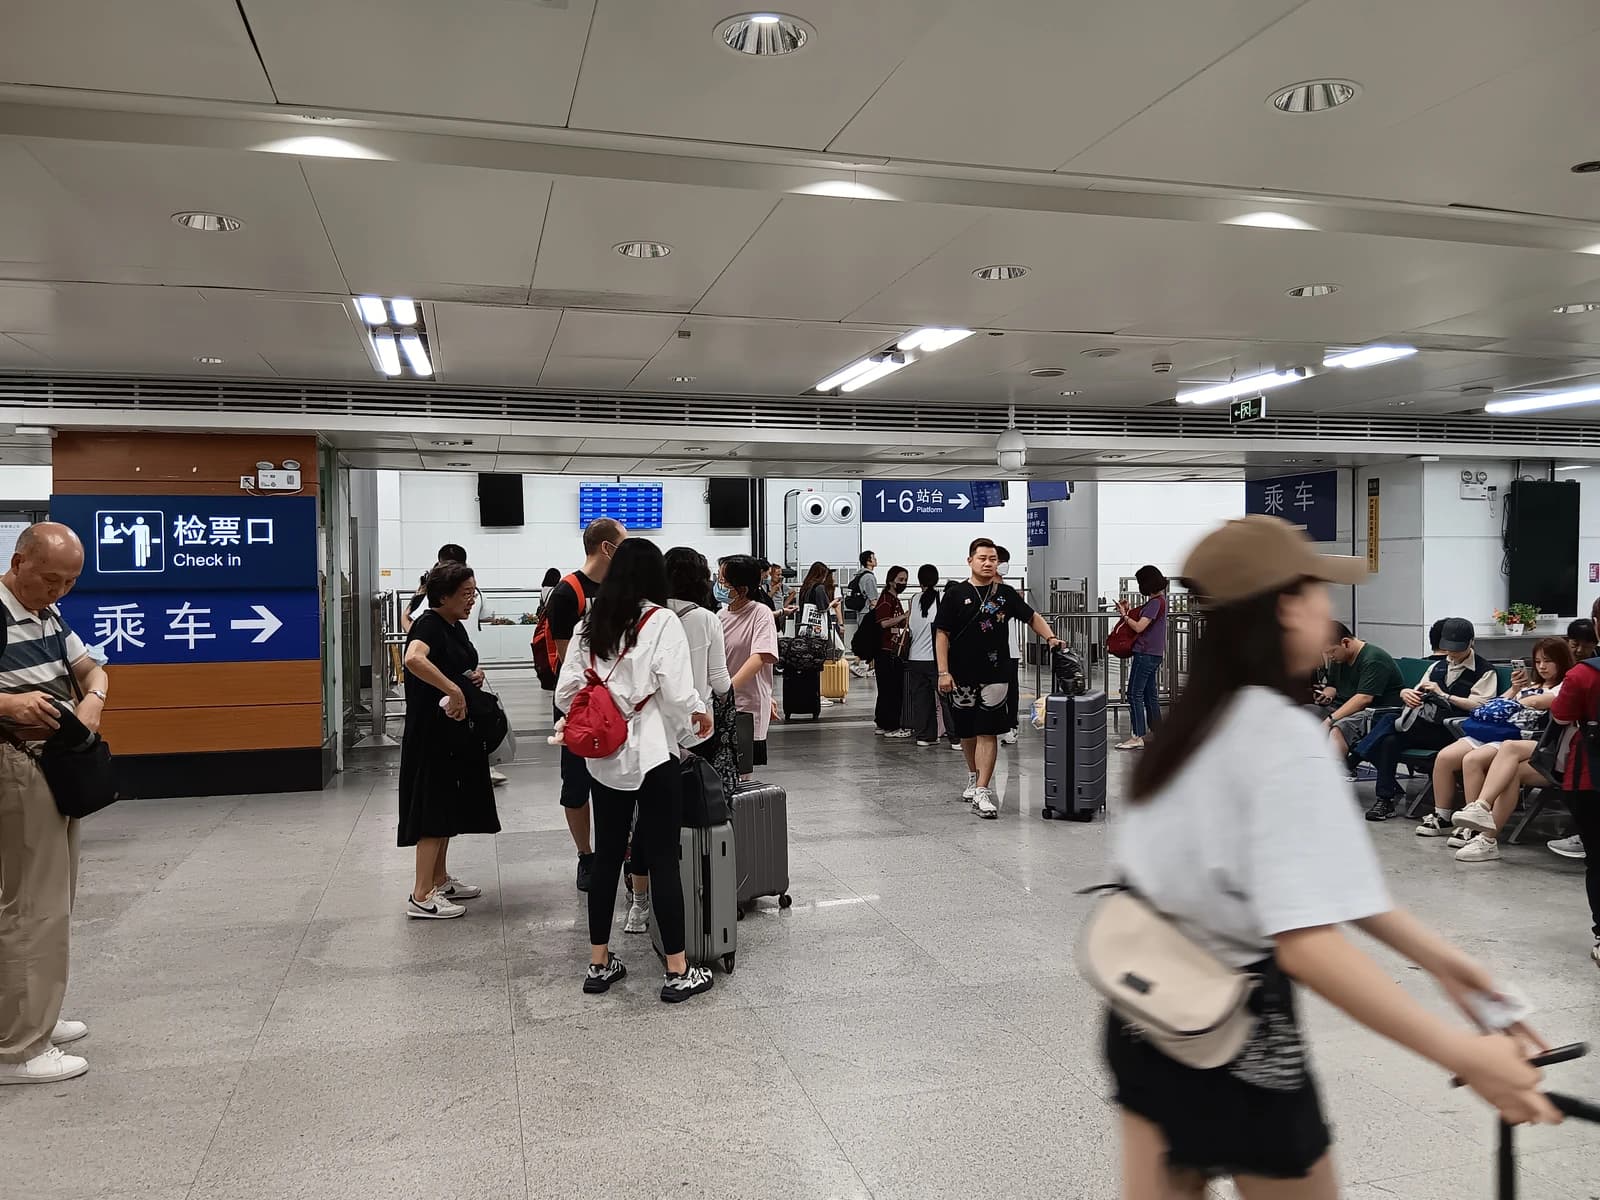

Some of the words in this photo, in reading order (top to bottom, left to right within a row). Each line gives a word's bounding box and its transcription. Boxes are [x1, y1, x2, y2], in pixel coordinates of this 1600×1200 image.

[875, 489, 914, 514] 1-6
[916, 488, 944, 504] 站台
[1264, 480, 1315, 514] 乘车
[173, 514, 274, 547] 检票口
[173, 552, 224, 567] Check
[227, 553, 241, 567] in
[94, 602, 217, 652] 乘车
